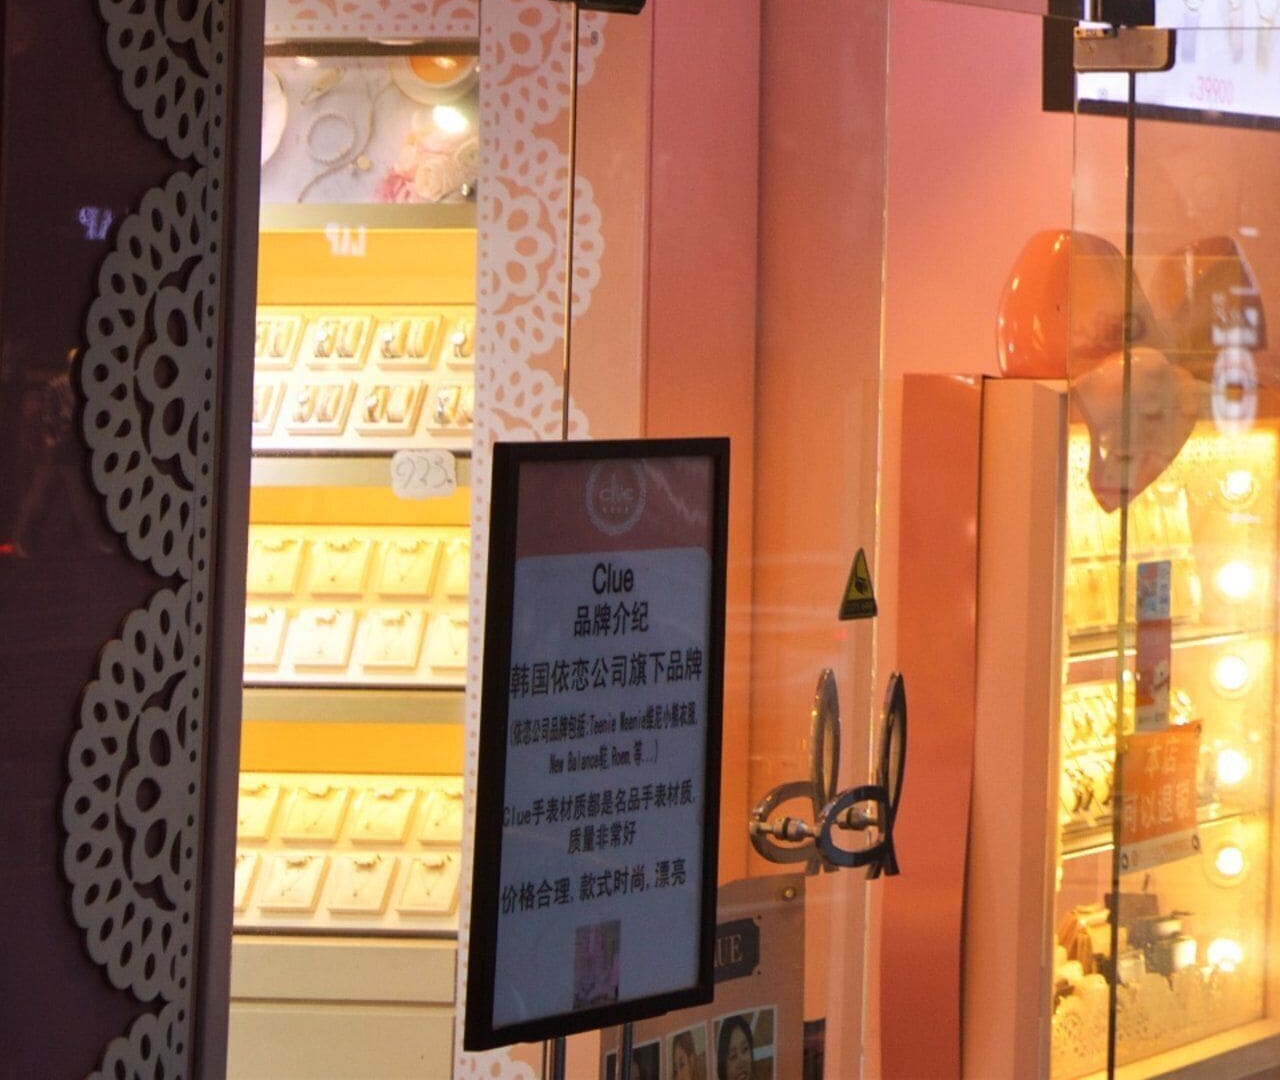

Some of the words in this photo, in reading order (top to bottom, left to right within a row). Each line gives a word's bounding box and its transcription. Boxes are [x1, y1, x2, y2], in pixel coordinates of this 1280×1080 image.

[592, 563, 634, 595] Clue
[510, 647, 702, 699] 韩国依恋公司旗下品牌
